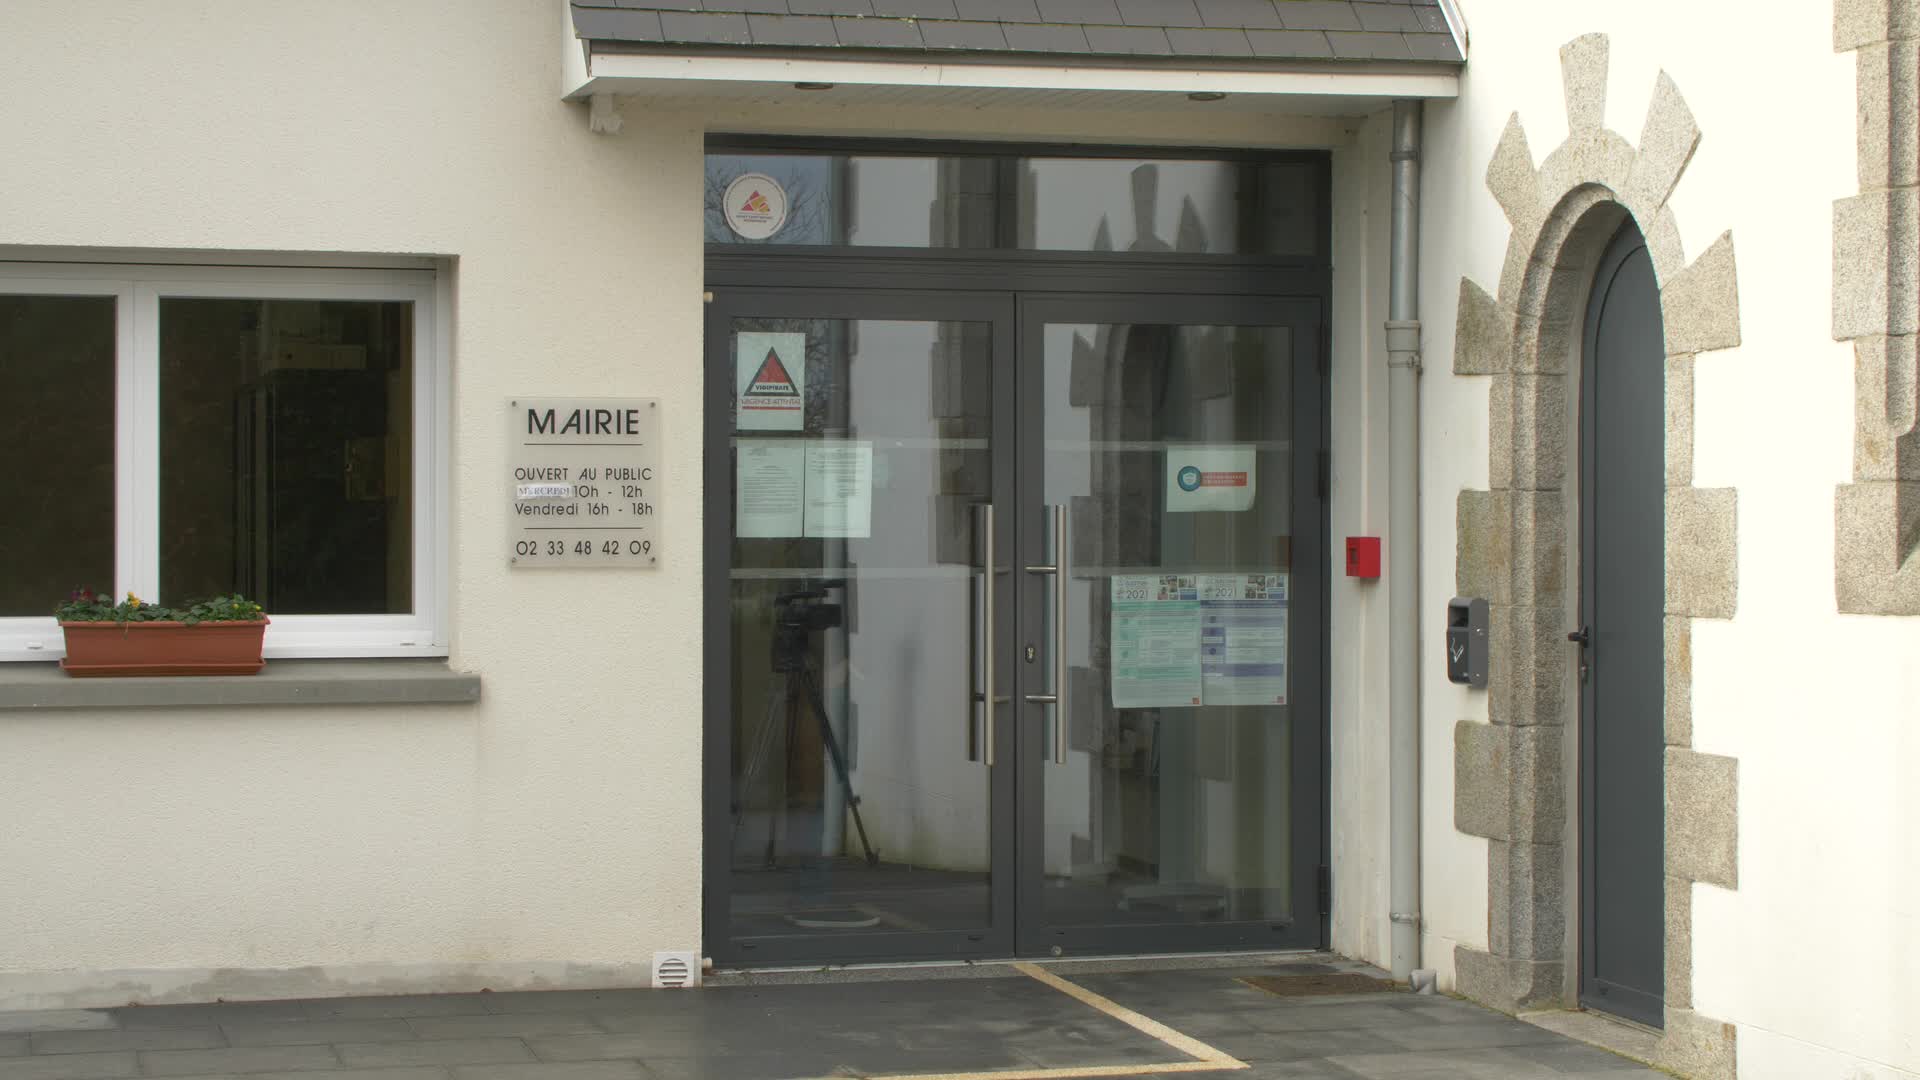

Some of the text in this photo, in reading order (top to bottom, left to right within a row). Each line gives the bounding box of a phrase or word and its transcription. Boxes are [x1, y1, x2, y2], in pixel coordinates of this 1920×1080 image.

[528, 408, 639, 435] MAIRIE
[514, 467, 652, 481] OUVERT AU PUBLIC
[574, 485, 599, 498] 10h
[621, 485, 643, 498] 12h
[514, 503, 579, 516] Vendredi
[587, 503, 609, 516] 16h
[632, 503, 653, 516] 18h
[516, 540, 651, 556] 02 33 48 42 09
